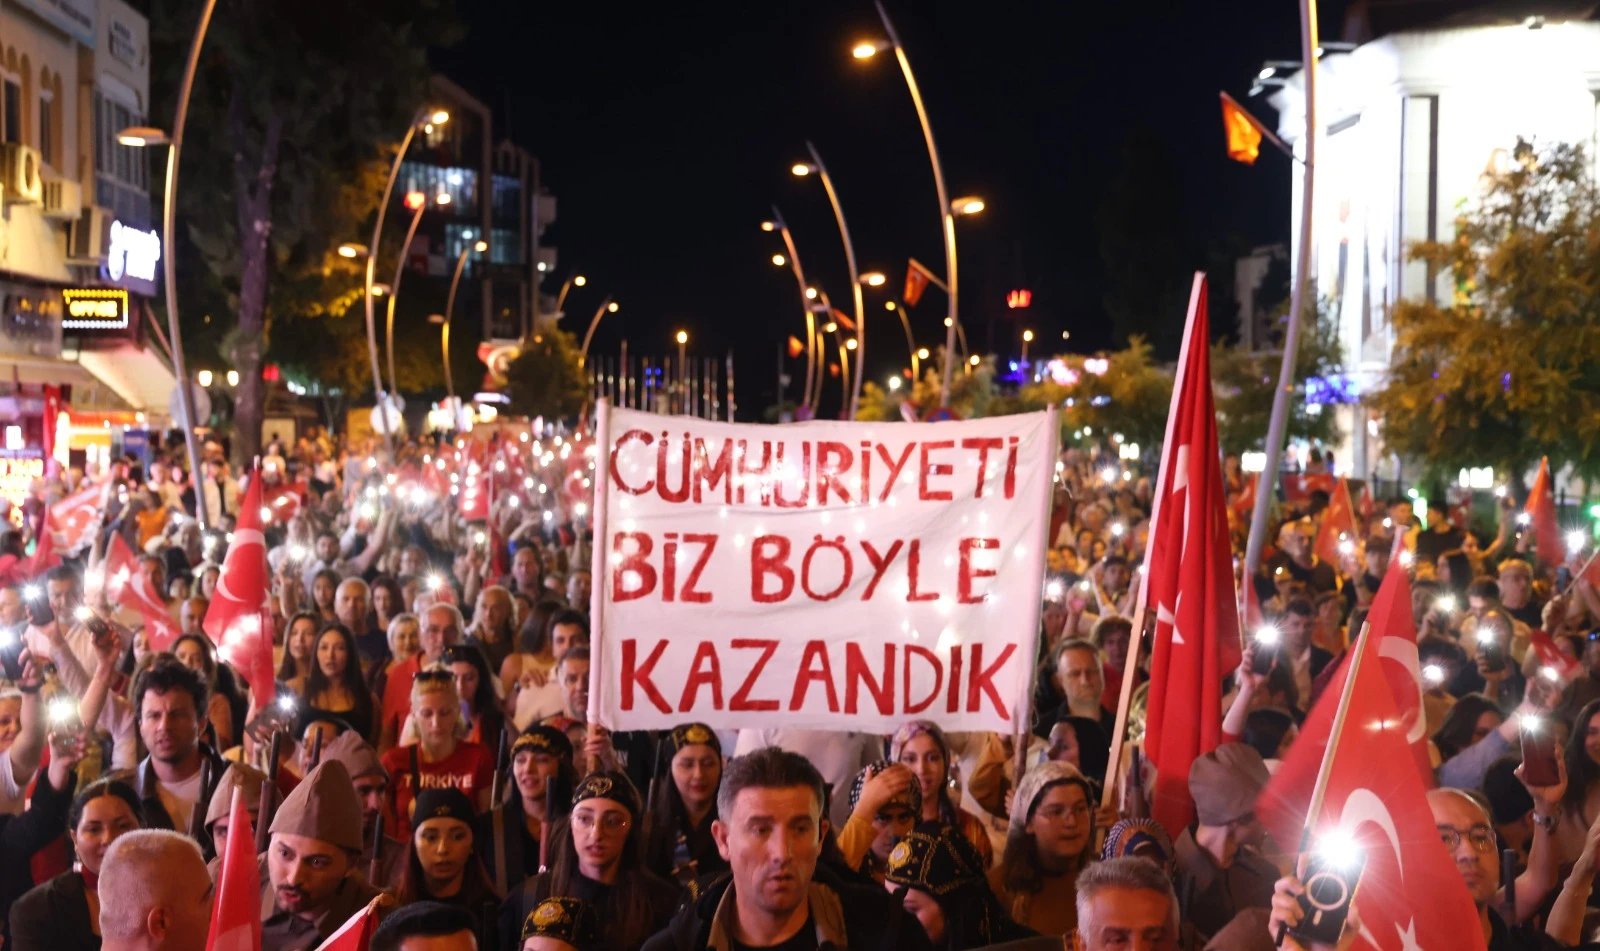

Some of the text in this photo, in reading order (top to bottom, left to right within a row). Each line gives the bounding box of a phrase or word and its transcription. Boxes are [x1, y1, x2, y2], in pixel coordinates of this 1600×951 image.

[609, 430, 1019, 509] CÜMHURİYETİ
[612, 532, 1000, 605] BİZ BÖYLE
[620, 638, 1018, 722] KAZANDIK
